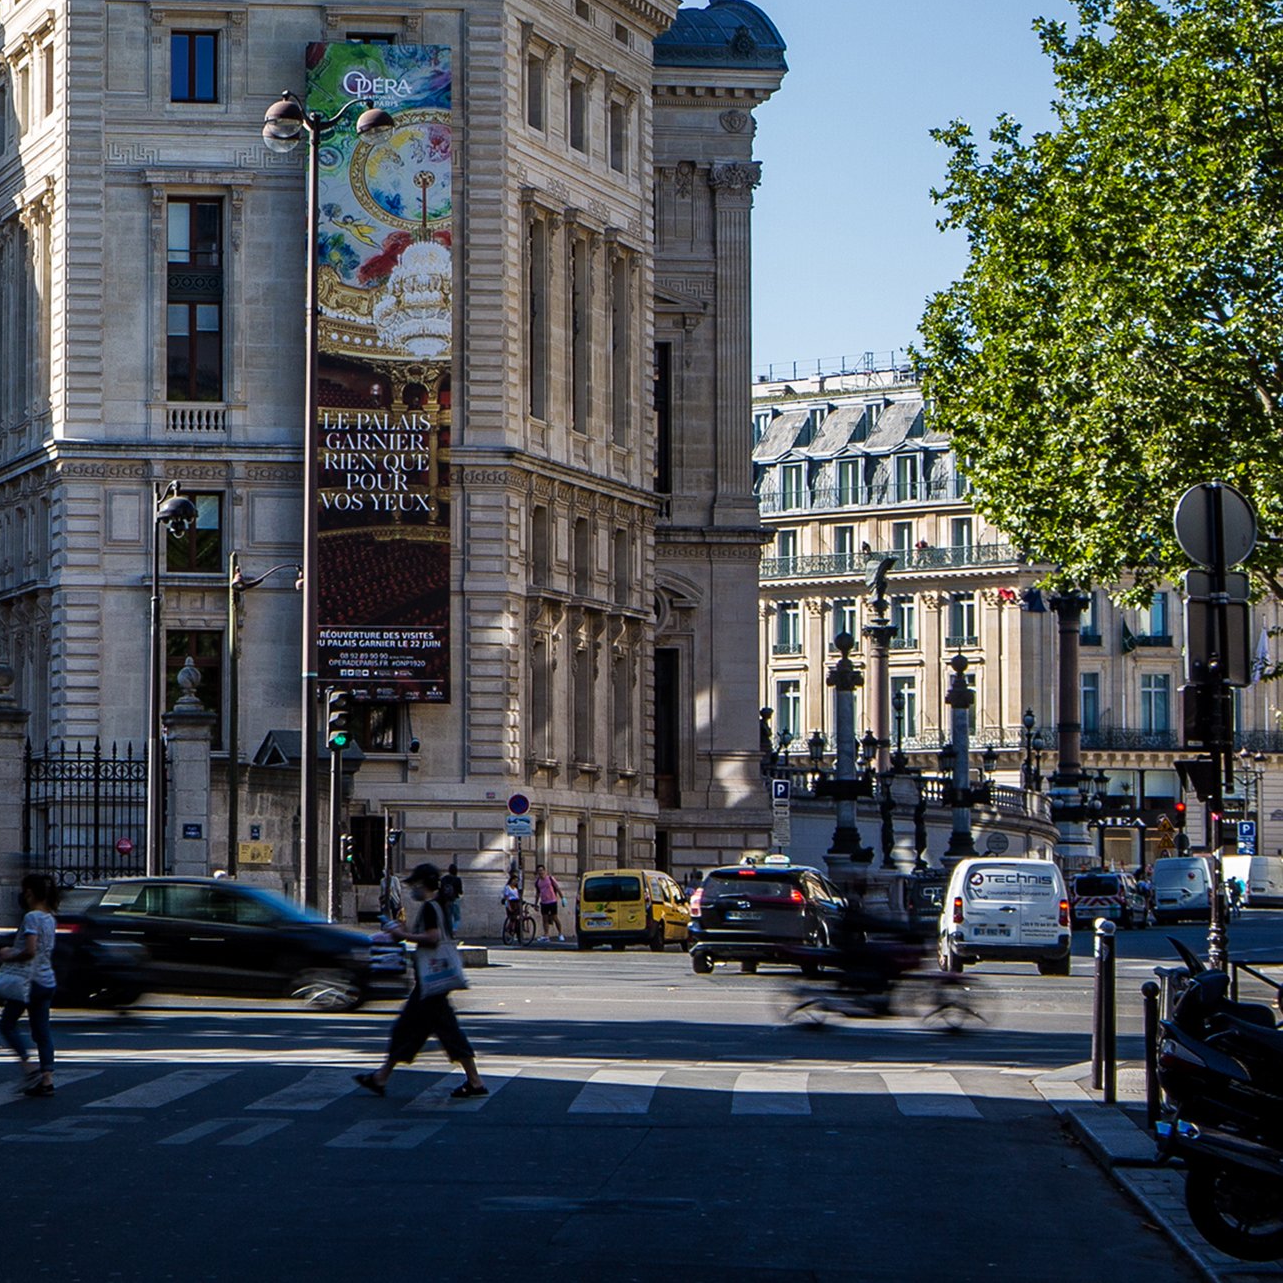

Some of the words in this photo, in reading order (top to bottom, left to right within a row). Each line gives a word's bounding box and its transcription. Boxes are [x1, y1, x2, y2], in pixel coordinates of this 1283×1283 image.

[343, 70, 413, 99] OPÉRA
[323, 412, 350, 430] LE
[357, 412, 431, 431] PALAIS
[325, 432, 430, 452] GARNIER,
[324, 452, 377, 471] RIEN
[383, 453, 430, 474] QUE
[346, 473, 409, 491] POUR
[320, 492, 364, 511] VOS
[370, 493, 435, 511] YEUX.
[319, 630, 381, 639] RÉOUVERTURE
[383, 632, 400, 640] DES
[401, 632, 434, 640] VISITES
[358, 640, 396, 648] GARNIER
[397, 640, 408, 648] LE
[410, 640, 420, 648] 22
[421, 640, 441, 649] JUIN
